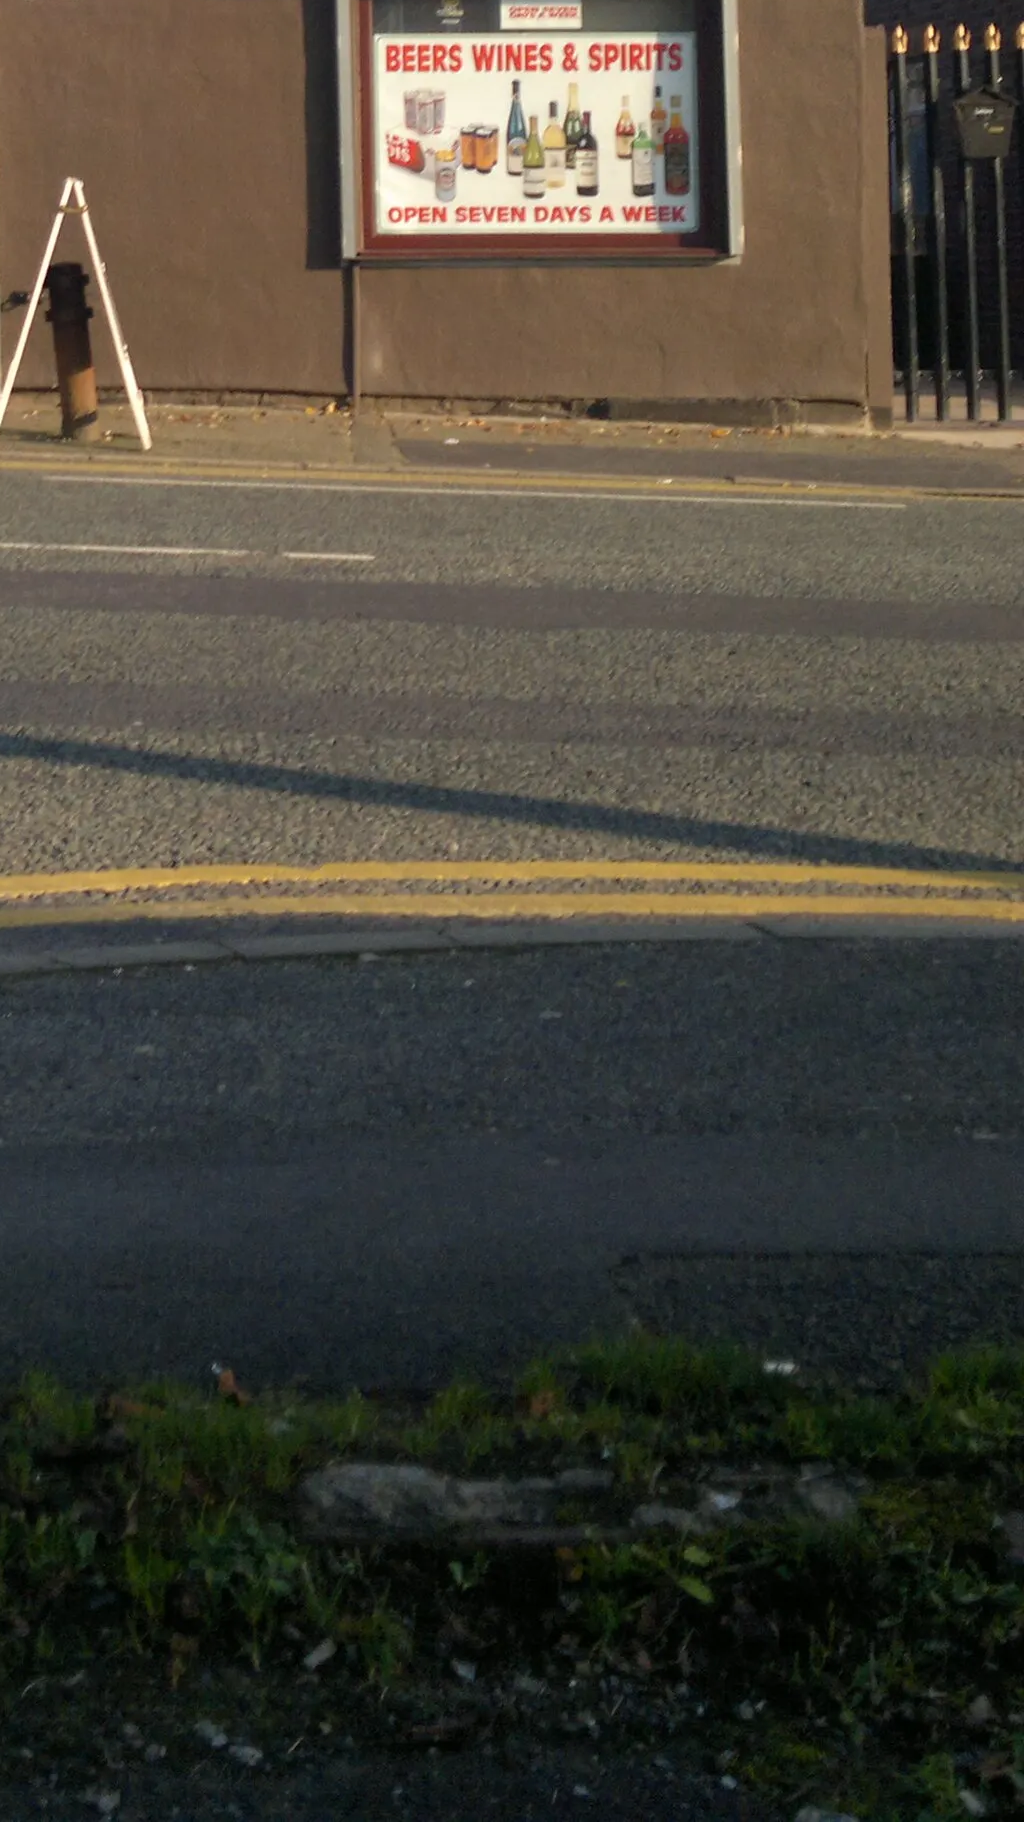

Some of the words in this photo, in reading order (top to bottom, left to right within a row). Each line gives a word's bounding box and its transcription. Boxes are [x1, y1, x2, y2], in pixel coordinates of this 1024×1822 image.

[386, 44, 463, 72] BEERS
[472, 44, 554, 72] WINES
[562, 43, 581, 71] &
[588, 43, 683, 71] SPIRITS
[388, 207, 447, 223] OPEN
[455, 206, 526, 223] SEVEN
[534, 206, 592, 222] DAYS
[598, 206, 614, 222] A
[621, 205, 685, 222] WEEK
